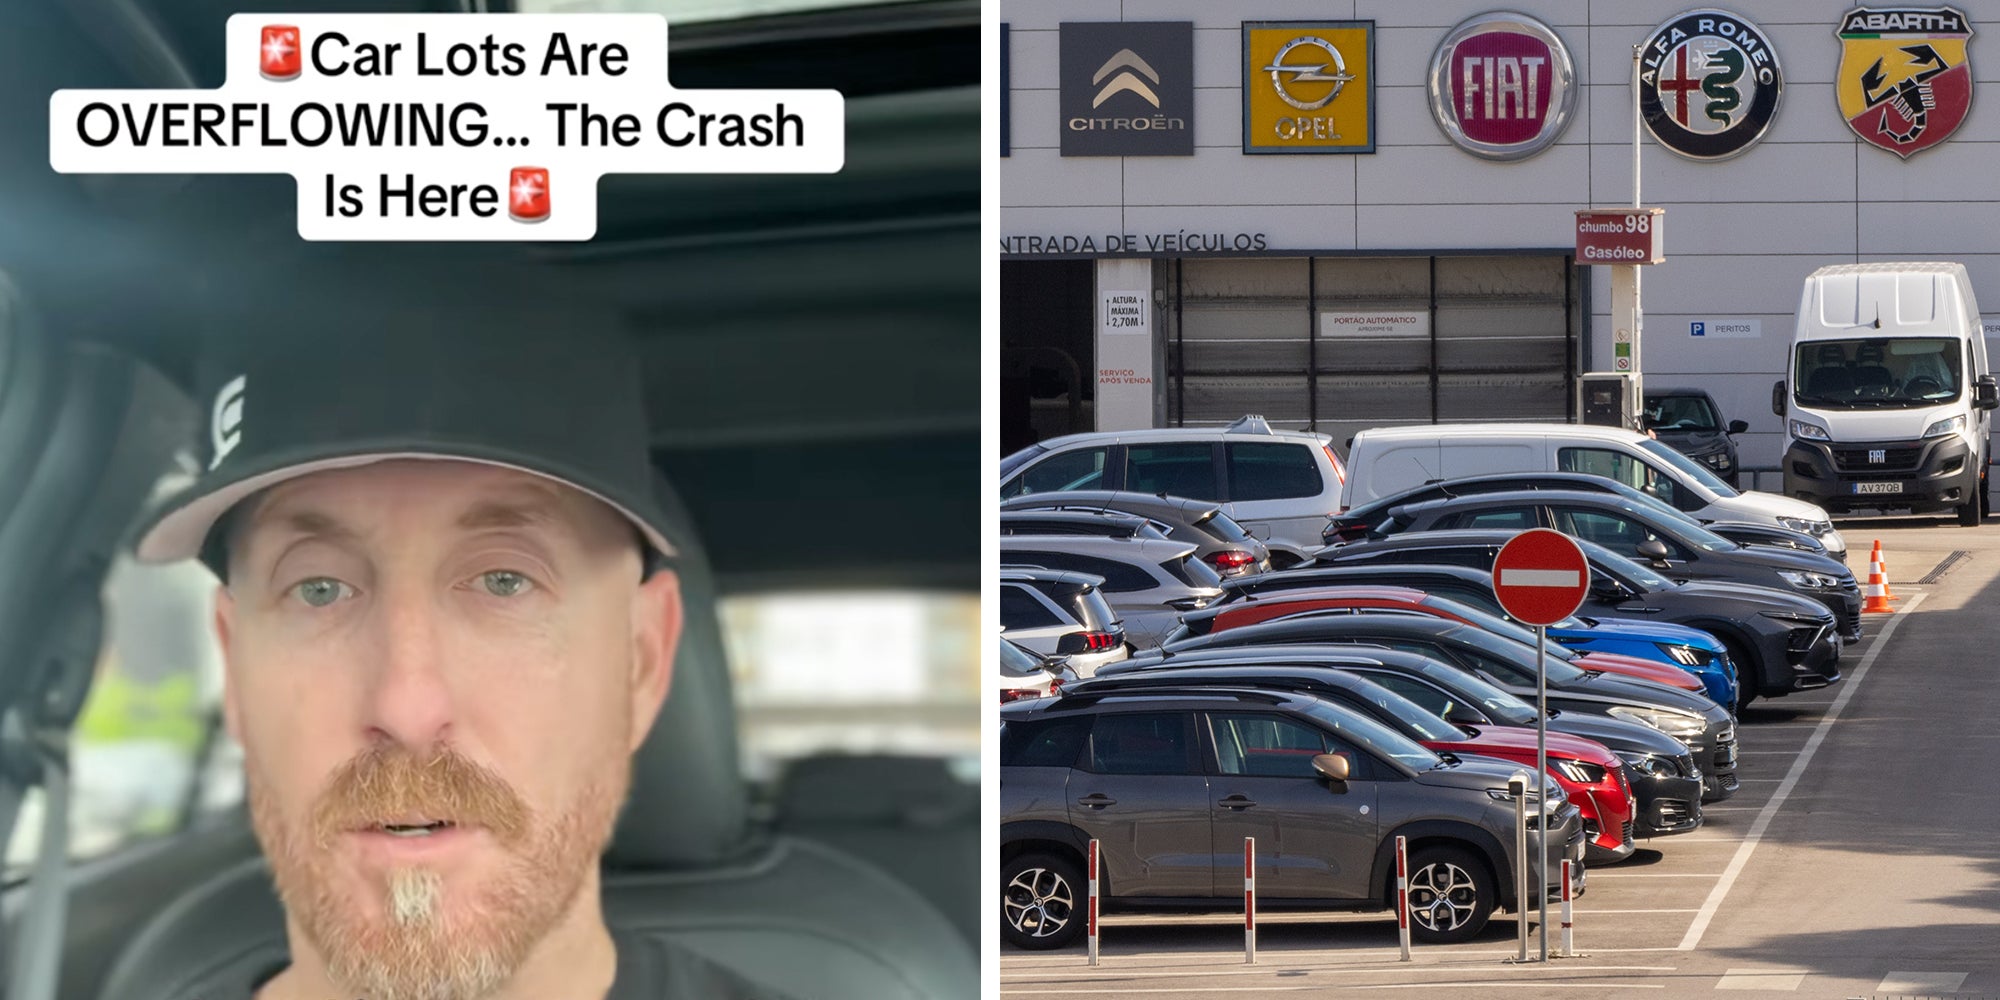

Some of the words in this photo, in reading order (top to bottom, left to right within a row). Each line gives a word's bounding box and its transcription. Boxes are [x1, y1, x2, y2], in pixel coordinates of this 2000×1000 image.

[1848, 13, 1958, 30] ABARTH
[1641, 27, 1687, 87] ALFA
[1698, 19, 1773, 85] ROMEO
[1463, 57, 1544, 119] FIAT
[1275, 117, 1341, 140] OPEL
[1579, 221, 1623, 233] chumbo
[1625, 215, 1649, 233] 98
[1106, 234, 1137, 252] DE
[1145, 229, 1267, 251] VEÍCULOS
[1584, 245, 1645, 259] Gasóleo
[1112, 296, 1138, 304] ALTURA
[1112, 317, 1138, 328] 2,70M
[1868, 449, 1886, 463] FIAT
